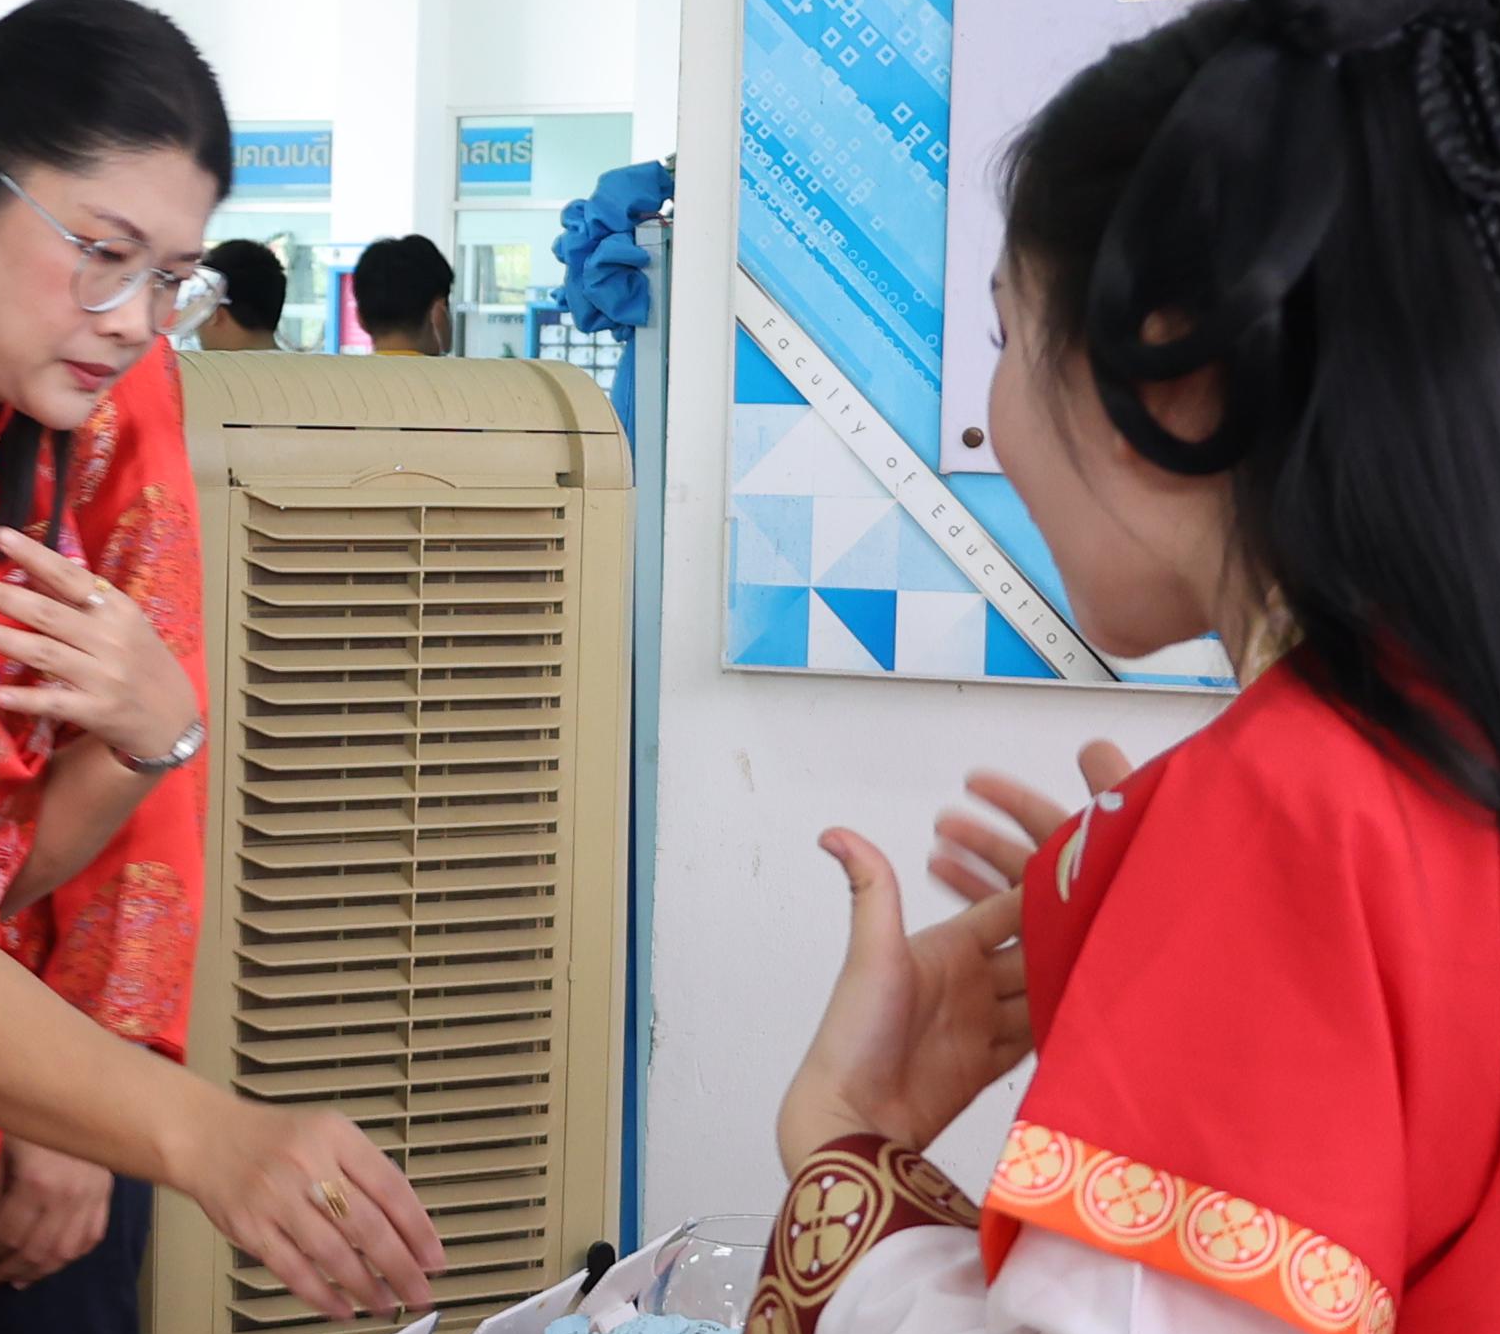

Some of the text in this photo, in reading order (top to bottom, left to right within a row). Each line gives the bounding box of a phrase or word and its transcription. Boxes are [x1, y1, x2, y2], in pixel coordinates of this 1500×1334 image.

[762, 317, 1076, 664] Faculty of Education
